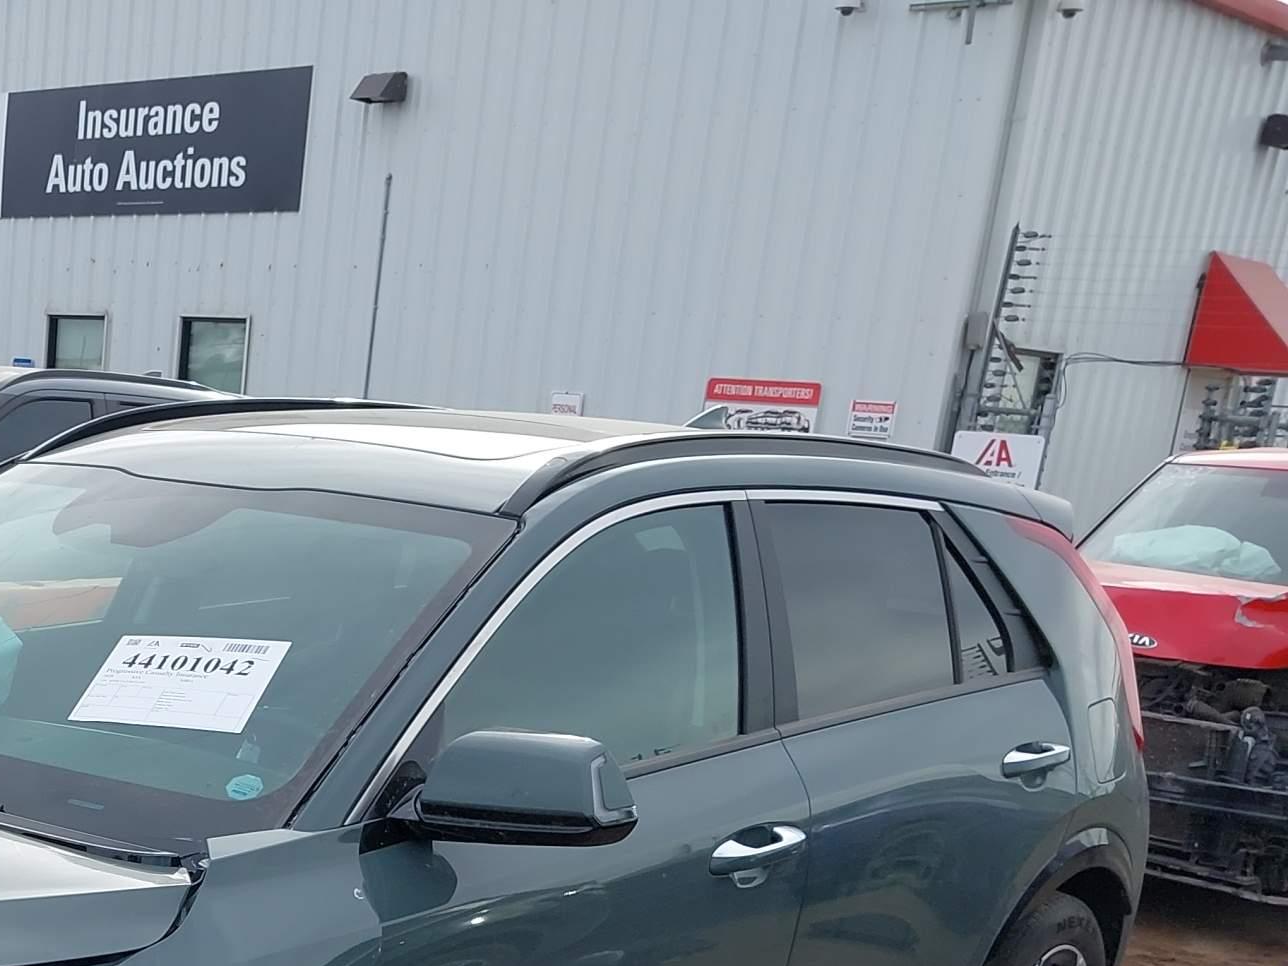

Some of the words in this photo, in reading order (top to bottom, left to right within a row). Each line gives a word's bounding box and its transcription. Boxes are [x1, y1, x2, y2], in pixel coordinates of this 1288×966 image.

[77, 100, 219, 140] Insurance
[45, 154, 109, 194] Auto
[115, 147, 247, 192] Auctions
[713, 383, 753, 397] ATTENTION
[754, 385, 814, 400] TRANSPORTERS!
[851, 423, 873, 432] Cameras
[853, 414, 874, 423] Security
[122, 652, 255, 676] 44101042
